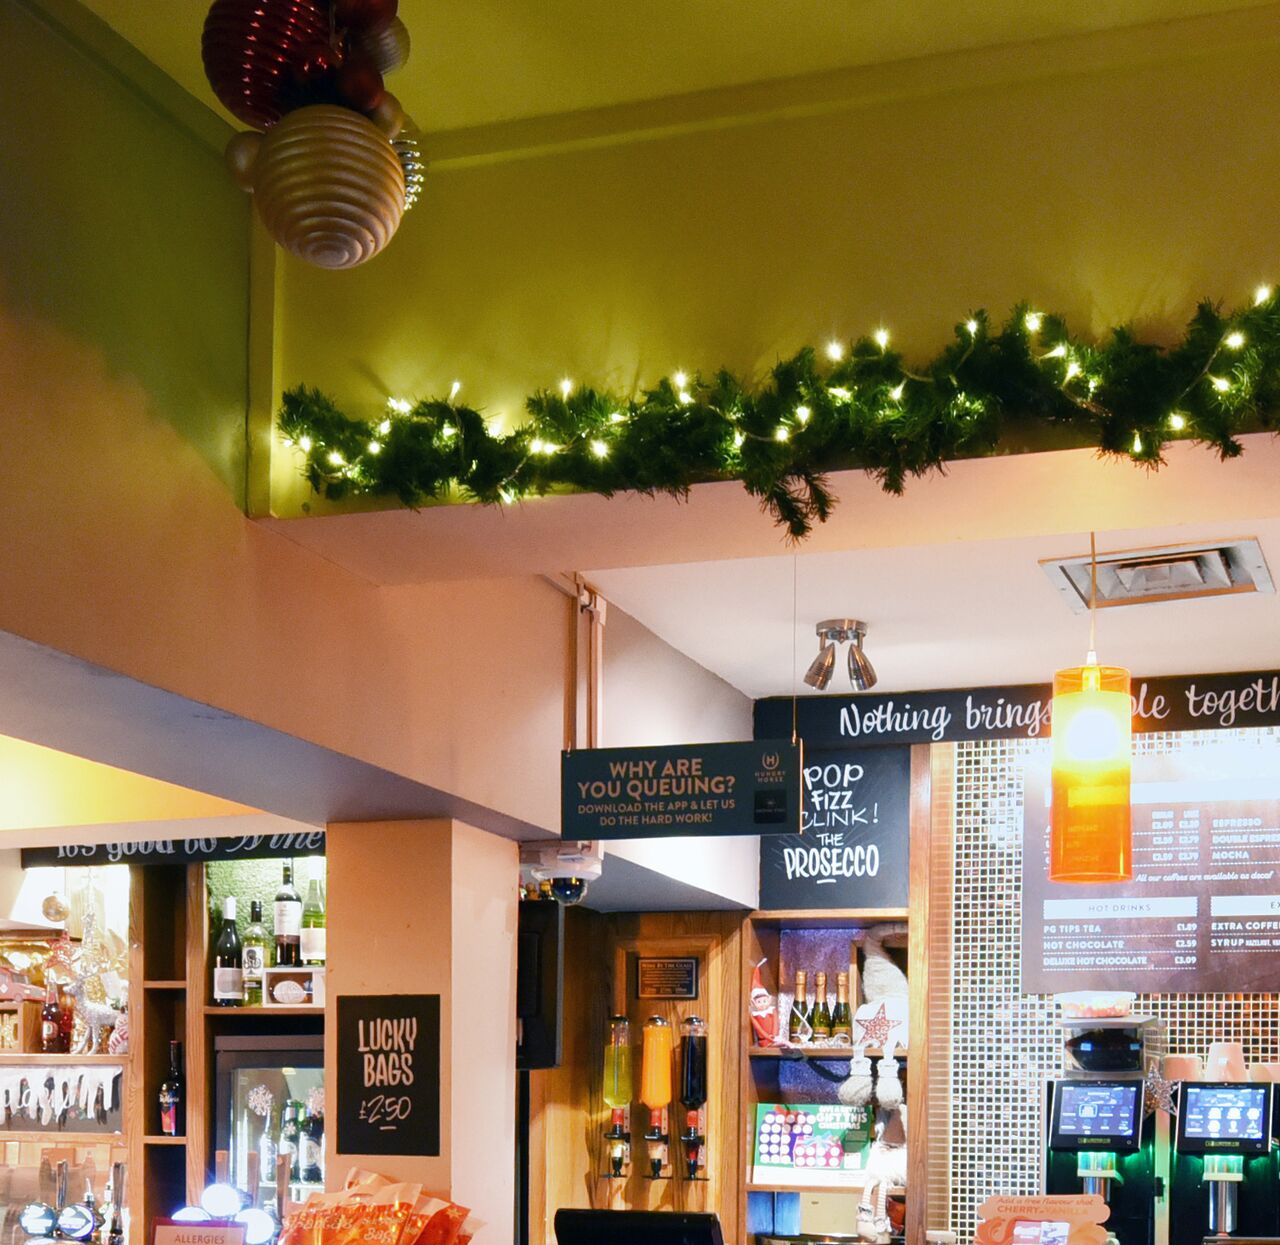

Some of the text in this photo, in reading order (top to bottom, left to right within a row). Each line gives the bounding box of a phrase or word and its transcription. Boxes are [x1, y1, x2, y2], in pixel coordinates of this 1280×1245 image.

[839, 701, 951, 741] Nothing
[966, 695, 1053, 736] brings
[610, 758, 702, 778] WHY ARE
[803, 764, 864, 790] POP
[578, 776, 736, 800] YOU QUEUING?
[578, 799, 735, 814] DOWNLOAD THE APP & LET US
[811, 790, 853, 811] FIZZ
[600, 813, 712, 826] DO THE HARD WORK!
[1213, 818, 1262, 828] ESPRESSO
[816, 833, 844, 846] THE
[1212, 834, 1248, 844] DOUBLE
[1212, 851, 1249, 860] MOCHA
[784, 844, 879, 880] PROSECCO
[1136, 874, 1148, 882] All
[1204, 872, 1238, 881] available
[1251, 871, 1274, 880] decaf
[1043, 925, 1056, 933] PG
[1059, 925, 1080, 933] TIPS
[1082, 924, 1101, 933] TEA
[1211, 922, 1243, 930] EXTRA
[1043, 941, 1064, 950] HOT
[1066, 940, 1124, 949] CHOCOLATE
[1211, 938, 1245, 947] SYRUP
[1043, 957, 1076, 966] DELUXE
[1077, 957, 1095, 965] HOT
[1096, 956, 1147, 965] CHOCOLATE
[358, 1017, 417, 1053] LUCKY
[363, 1053, 414, 1087] BAGS
[359, 1095, 411, 1123] £2.50
[816, 1112, 868, 1123] GIFT THIS
[997, 1205, 1088, 1215] CHERRY VANILLA
[174, 1234, 225, 1245] ALLERGIES
